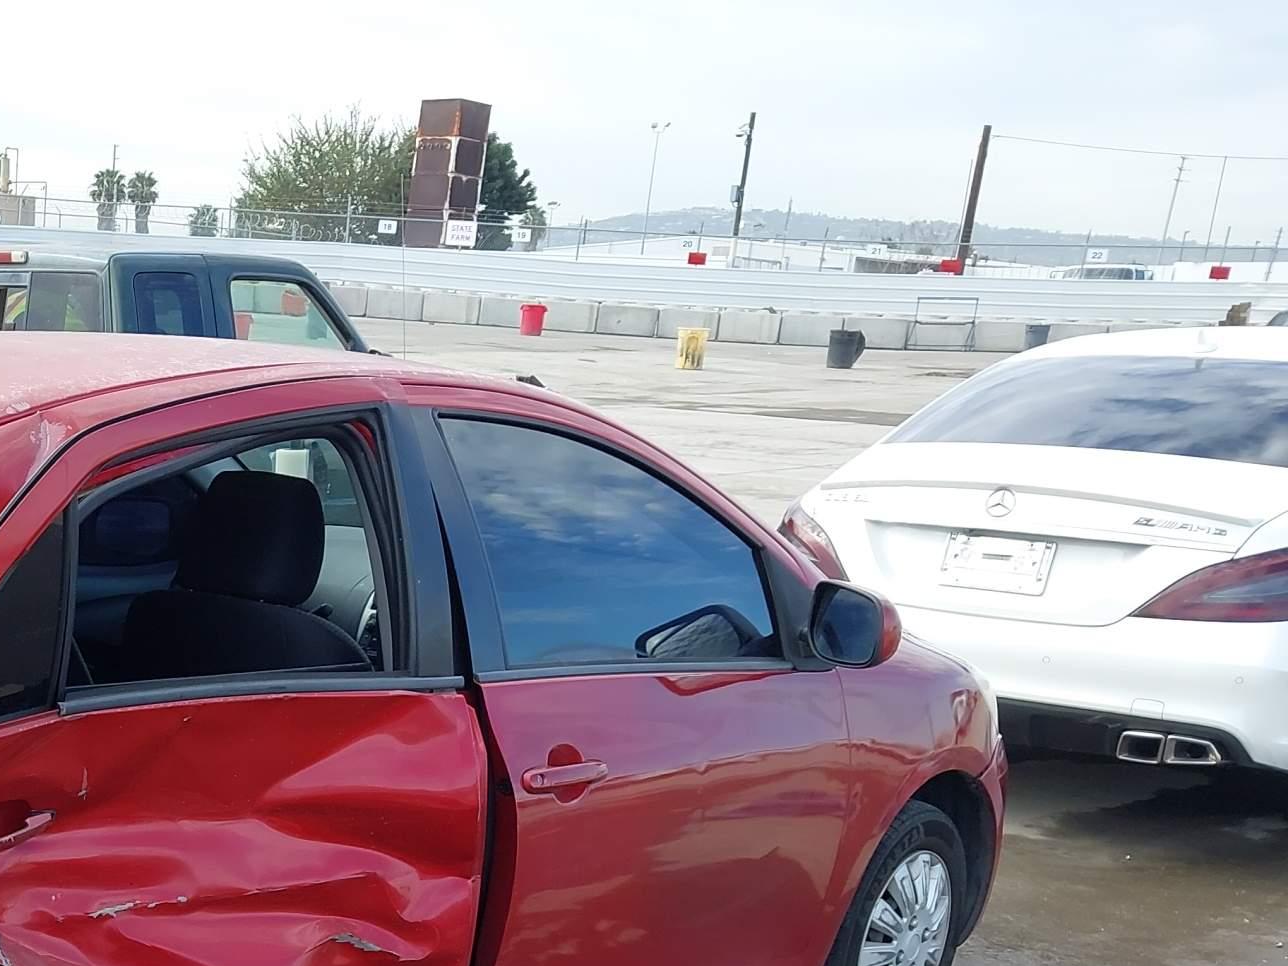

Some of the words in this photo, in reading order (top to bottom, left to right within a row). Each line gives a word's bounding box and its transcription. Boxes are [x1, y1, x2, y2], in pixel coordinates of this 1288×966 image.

[451, 225, 473, 233] STATE
[451, 233, 472, 241] FARM
[682, 240, 693, 248] 20
[872, 247, 882, 255] 21
[1091, 251, 1103, 259] 22
